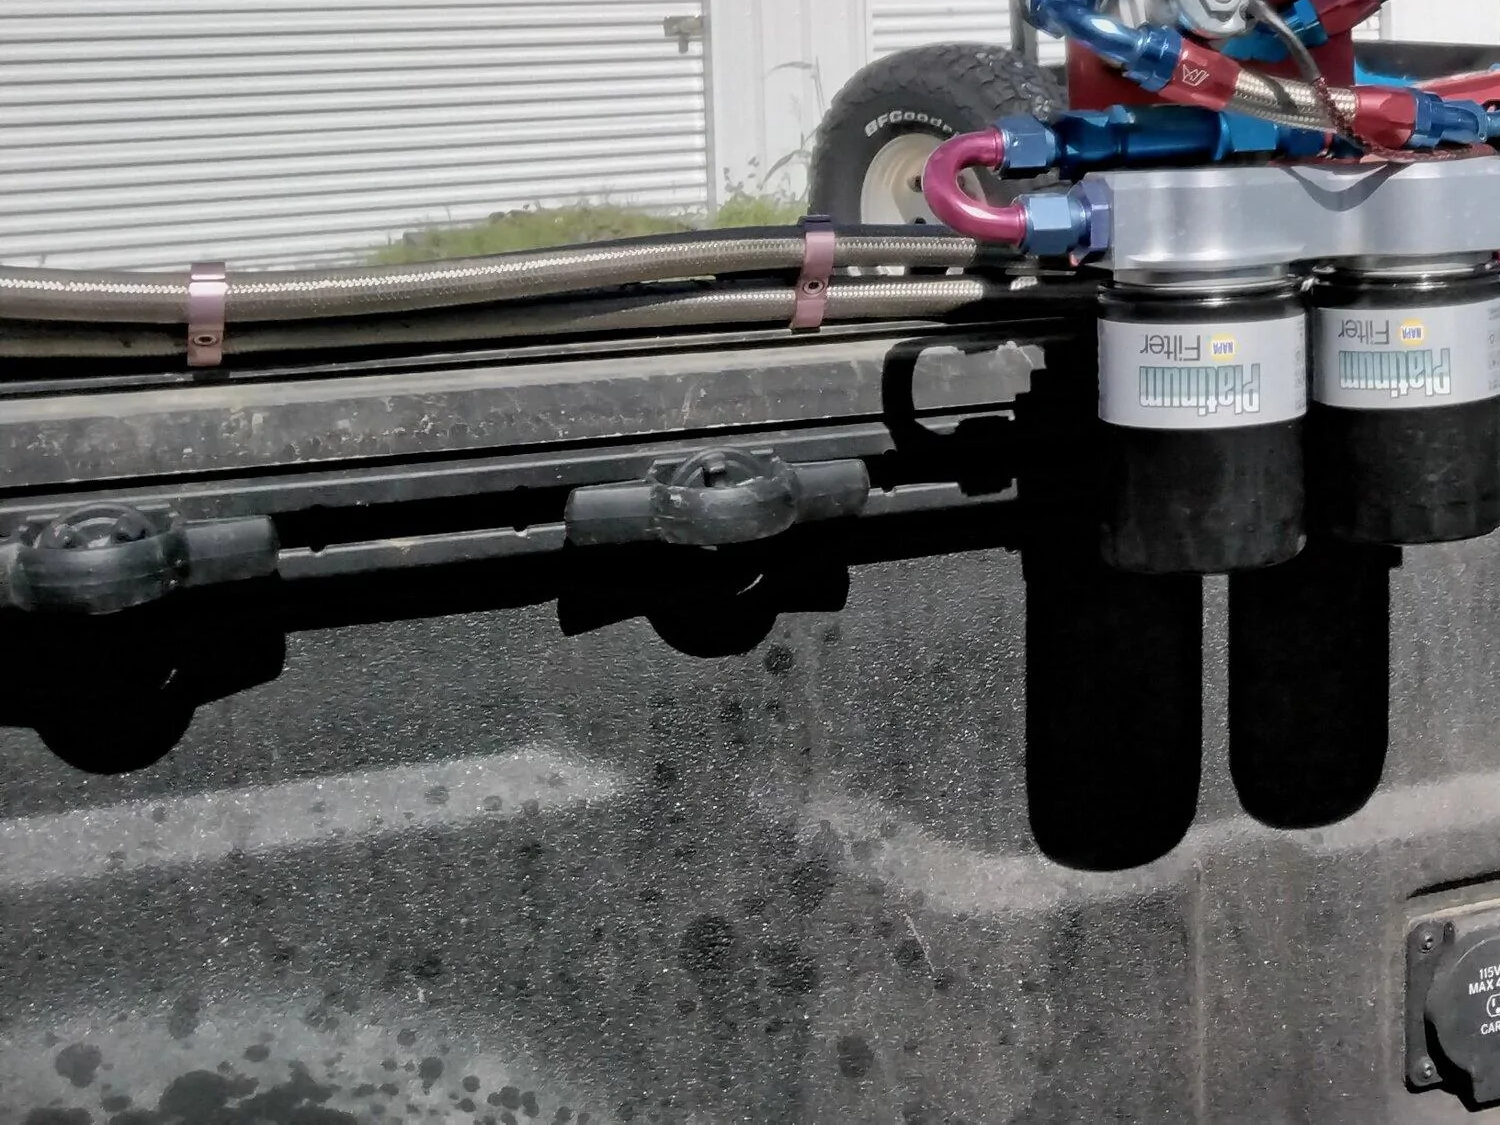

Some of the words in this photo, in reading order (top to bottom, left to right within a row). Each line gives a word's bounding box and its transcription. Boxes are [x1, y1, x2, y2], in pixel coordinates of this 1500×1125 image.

[864, 110, 956, 137] BFGoodr
[1337, 319, 1390, 345] Filter
[1402, 328, 1422, 339] NAPA
[1139, 335, 1201, 361] Filter
[1213, 342, 1233, 354] NAPA
[1338, 348, 1452, 398] Platinum
[1138, 363, 1261, 416] Platinum
[1469, 979, 1494, 995] MAX
